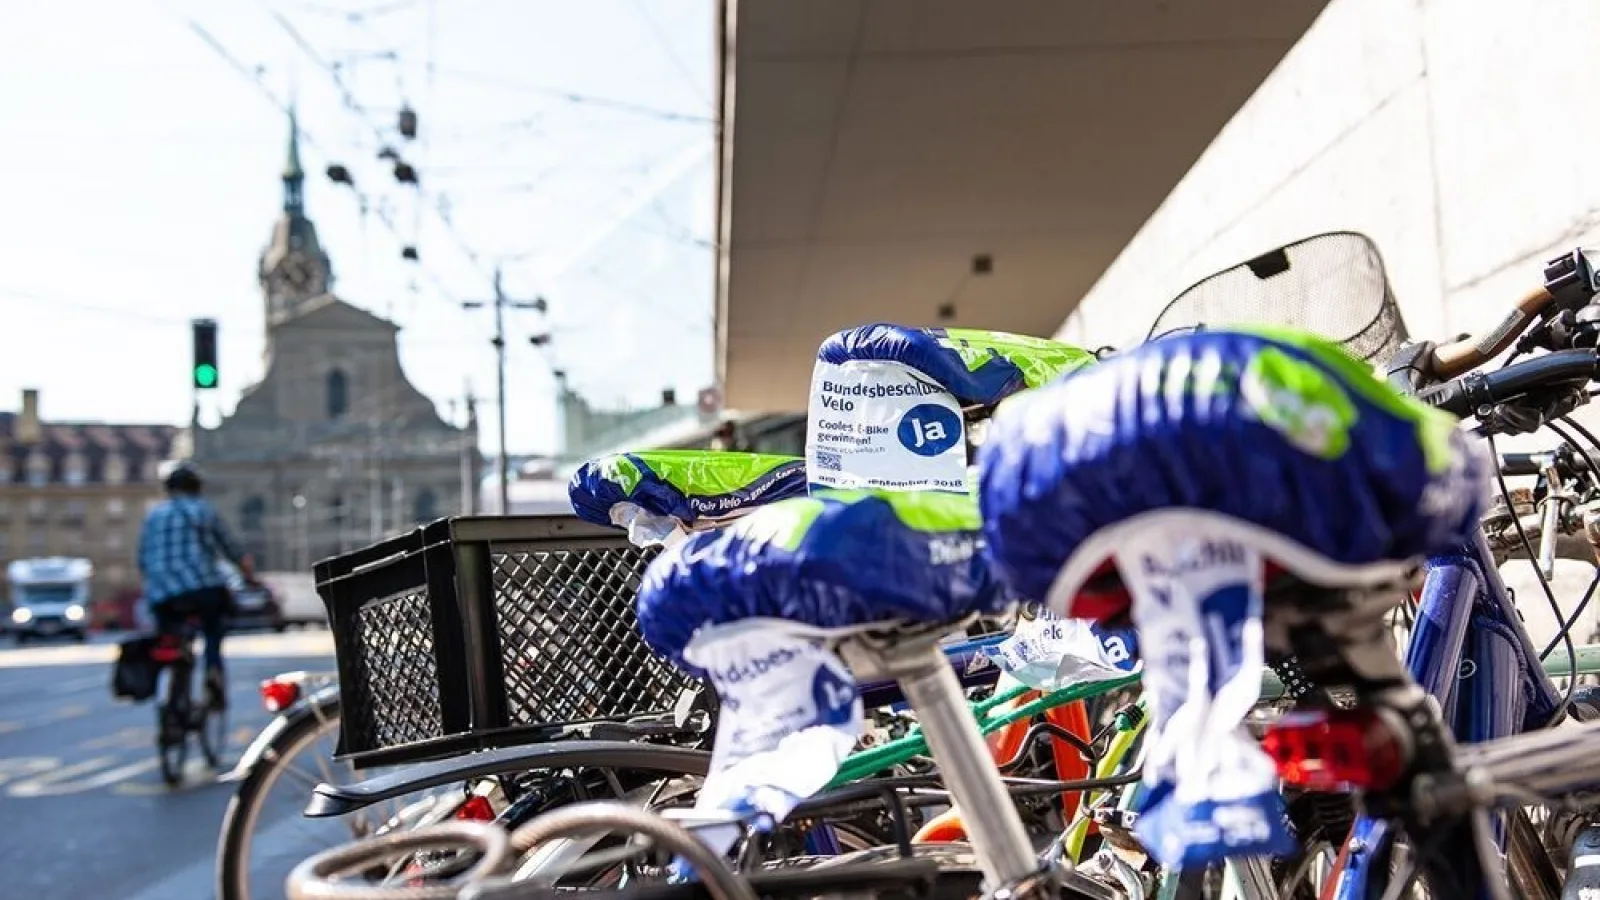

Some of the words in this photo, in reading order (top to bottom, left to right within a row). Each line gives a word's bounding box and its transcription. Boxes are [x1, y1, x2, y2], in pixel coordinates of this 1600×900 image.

[821, 395, 854, 411] Velo
[818, 420, 853, 432] Cooles
[911, 418, 947, 448] Ja
[719, 496, 742, 509] Velo
